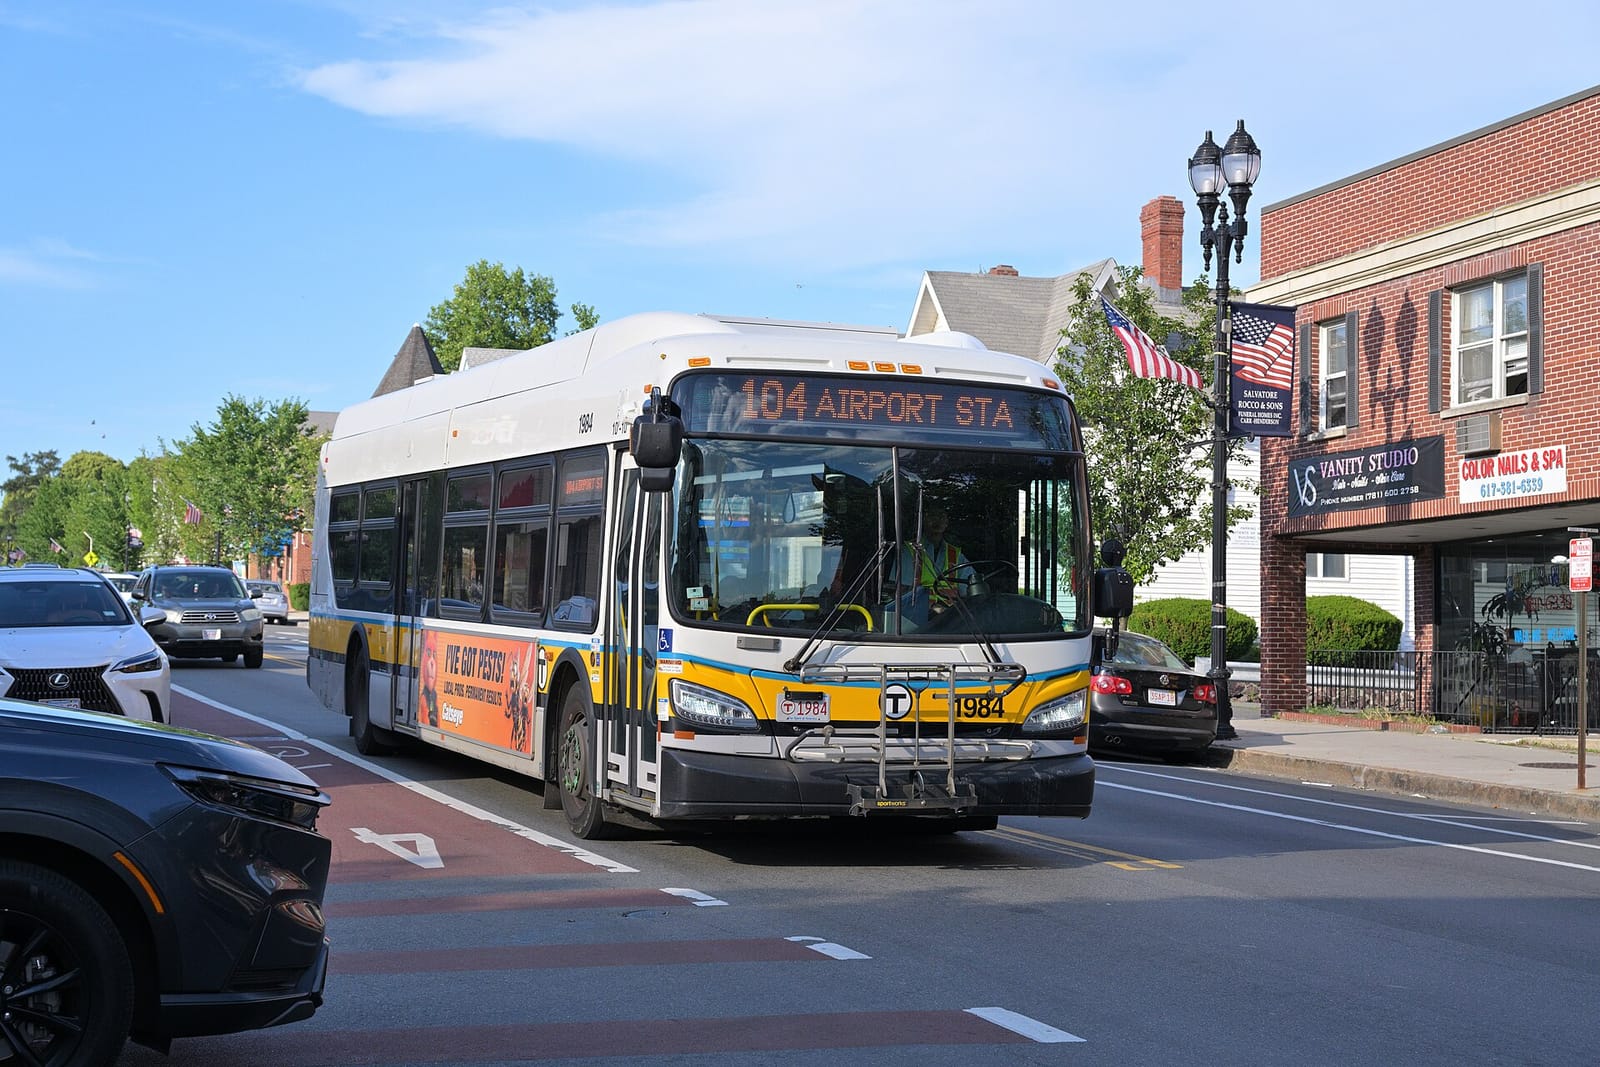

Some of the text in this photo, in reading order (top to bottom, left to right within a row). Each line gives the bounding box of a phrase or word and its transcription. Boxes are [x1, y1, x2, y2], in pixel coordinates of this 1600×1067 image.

[742, 379, 1013, 428] 104 AIRPORT STA
[1238, 400, 1259, 409] ROCCO
[1266, 402, 1283, 410] SONS
[1243, 390, 1278, 399] SALVATORE
[578, 411, 594, 434] 1984
[1320, 447, 1419, 478] VANITY STUDIO
[1462, 448, 1564, 481] COLOR NAILS & SPA
[1320, 485, 1419, 506] PHONE NUMBER (781) 600 2758
[1480, 477, 1543, 498] 617-381-6339
[445, 644, 506, 683] I'VE GOT PESTS!
[443, 680, 455, 695] LOCAL
[465, 684, 487, 702] PERMANENT
[797, 701, 827, 716] 1984
[954, 697, 1005, 718] 1984
